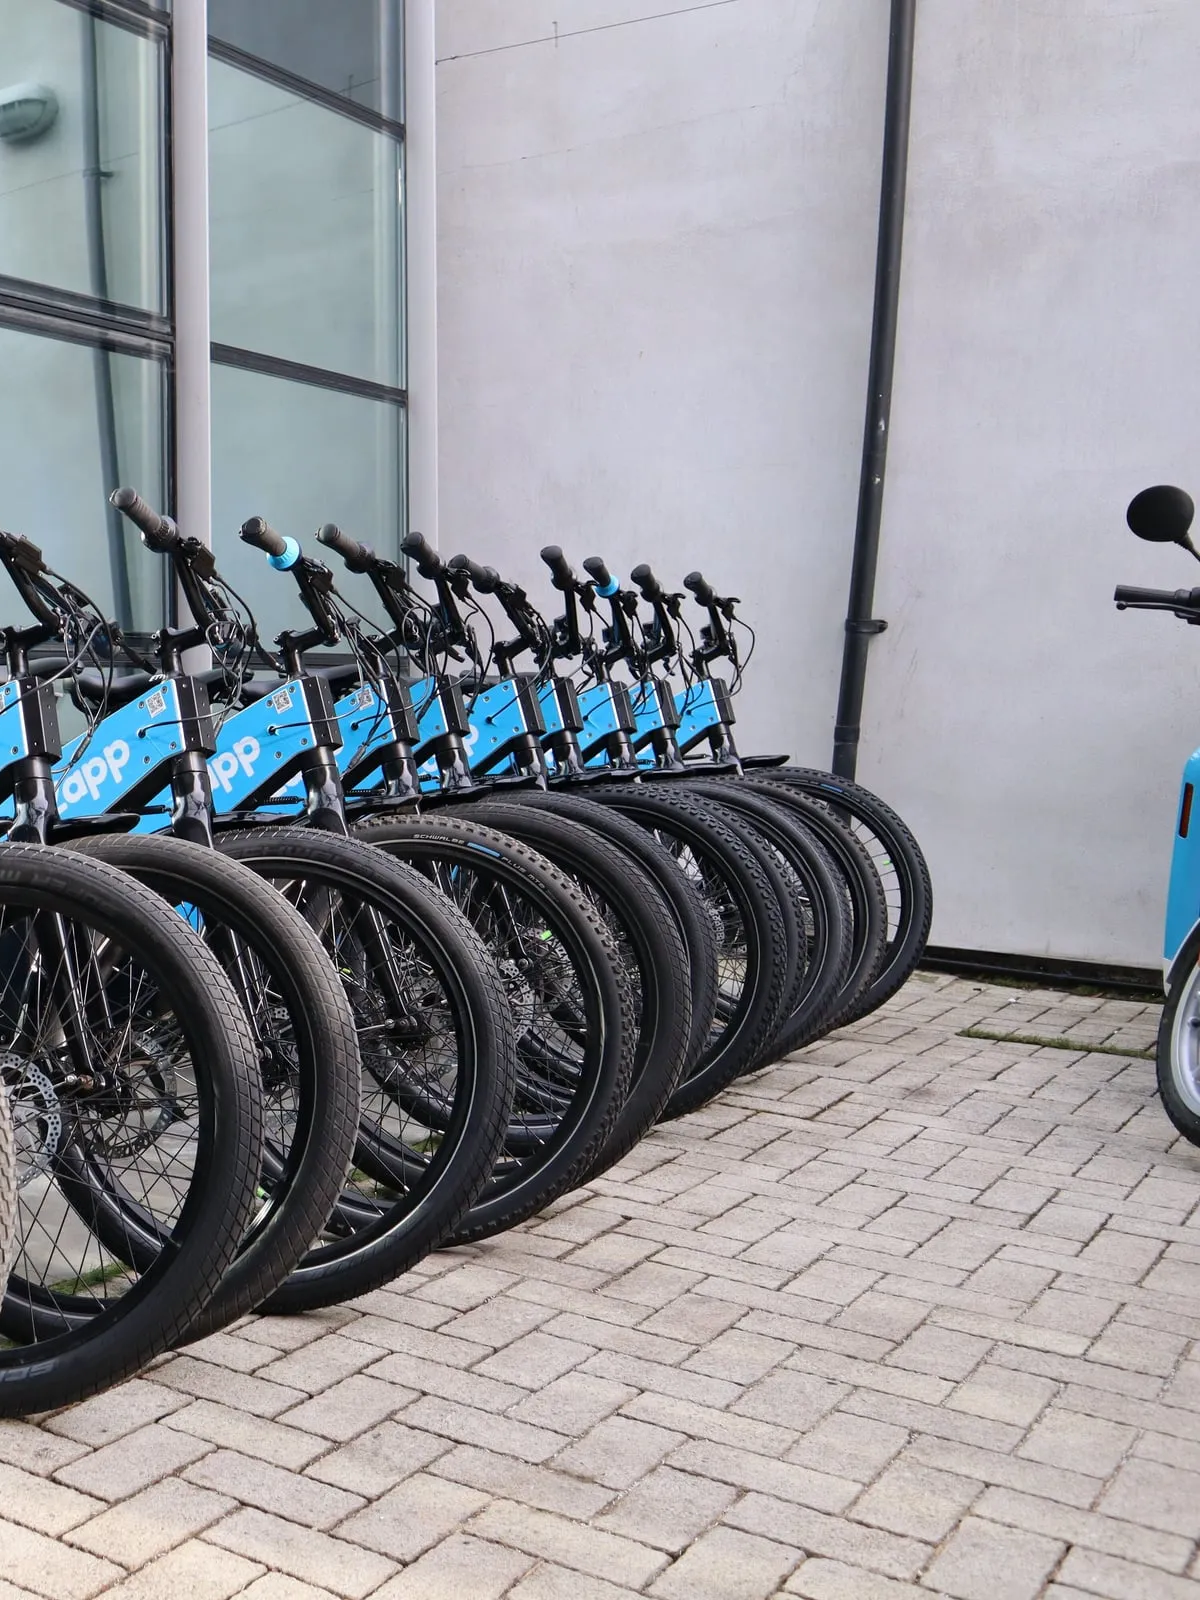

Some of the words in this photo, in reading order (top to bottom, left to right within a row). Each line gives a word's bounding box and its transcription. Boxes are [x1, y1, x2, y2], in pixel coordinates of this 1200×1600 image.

[54, 739, 130, 814] app
[413, 833, 465, 845] SCHWALBE
[501, 856, 527, 873] PLUS
